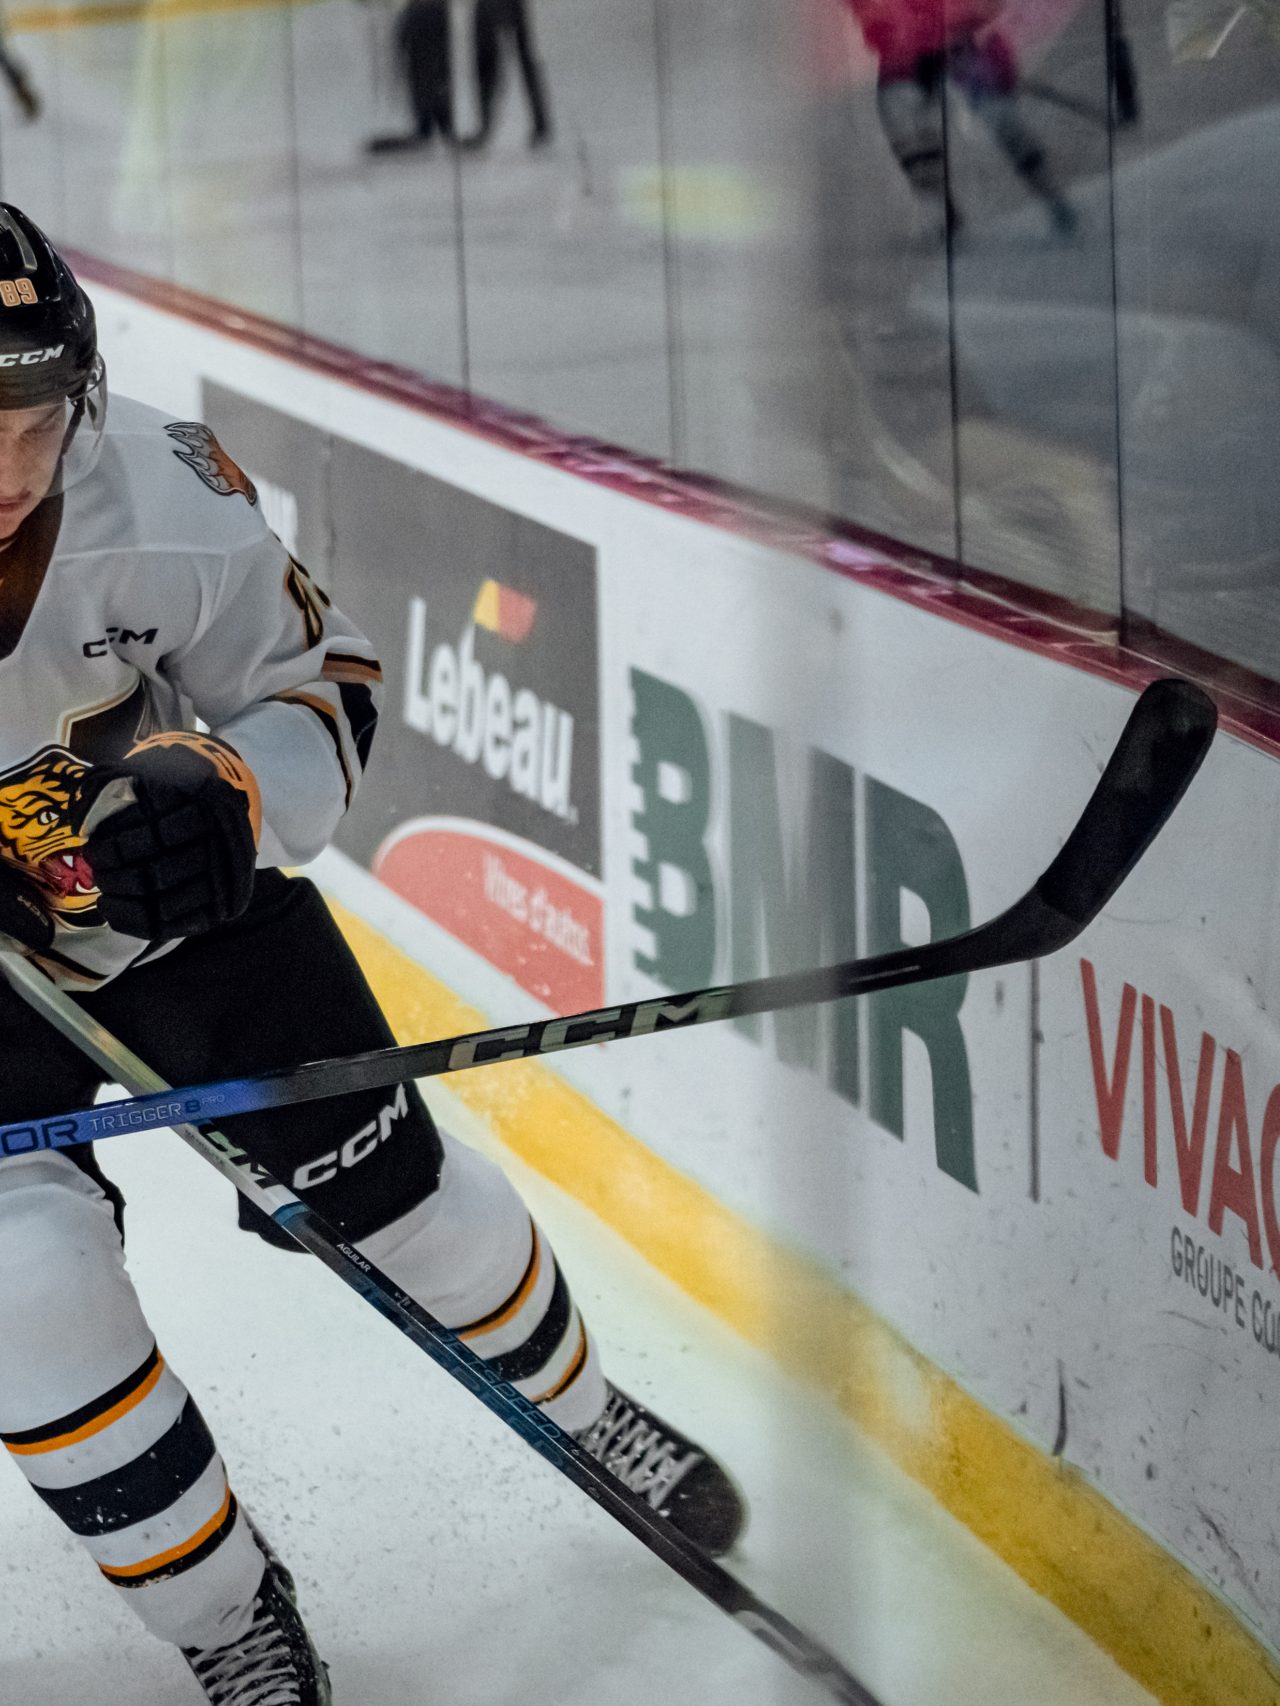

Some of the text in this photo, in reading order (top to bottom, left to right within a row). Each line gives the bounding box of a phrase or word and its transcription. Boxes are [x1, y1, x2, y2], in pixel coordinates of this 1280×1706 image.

[404, 596, 574, 820] Lebeau
[630, 667, 980, 1196] BMR
[449, 989, 734, 1070] CCM
[88, 1102, 183, 1133] TRIGGER
[293, 1082, 408, 1190] CCM
[336, 1243, 371, 1272] AGUILAR
[1171, 1225, 1247, 1329] GROUPE
